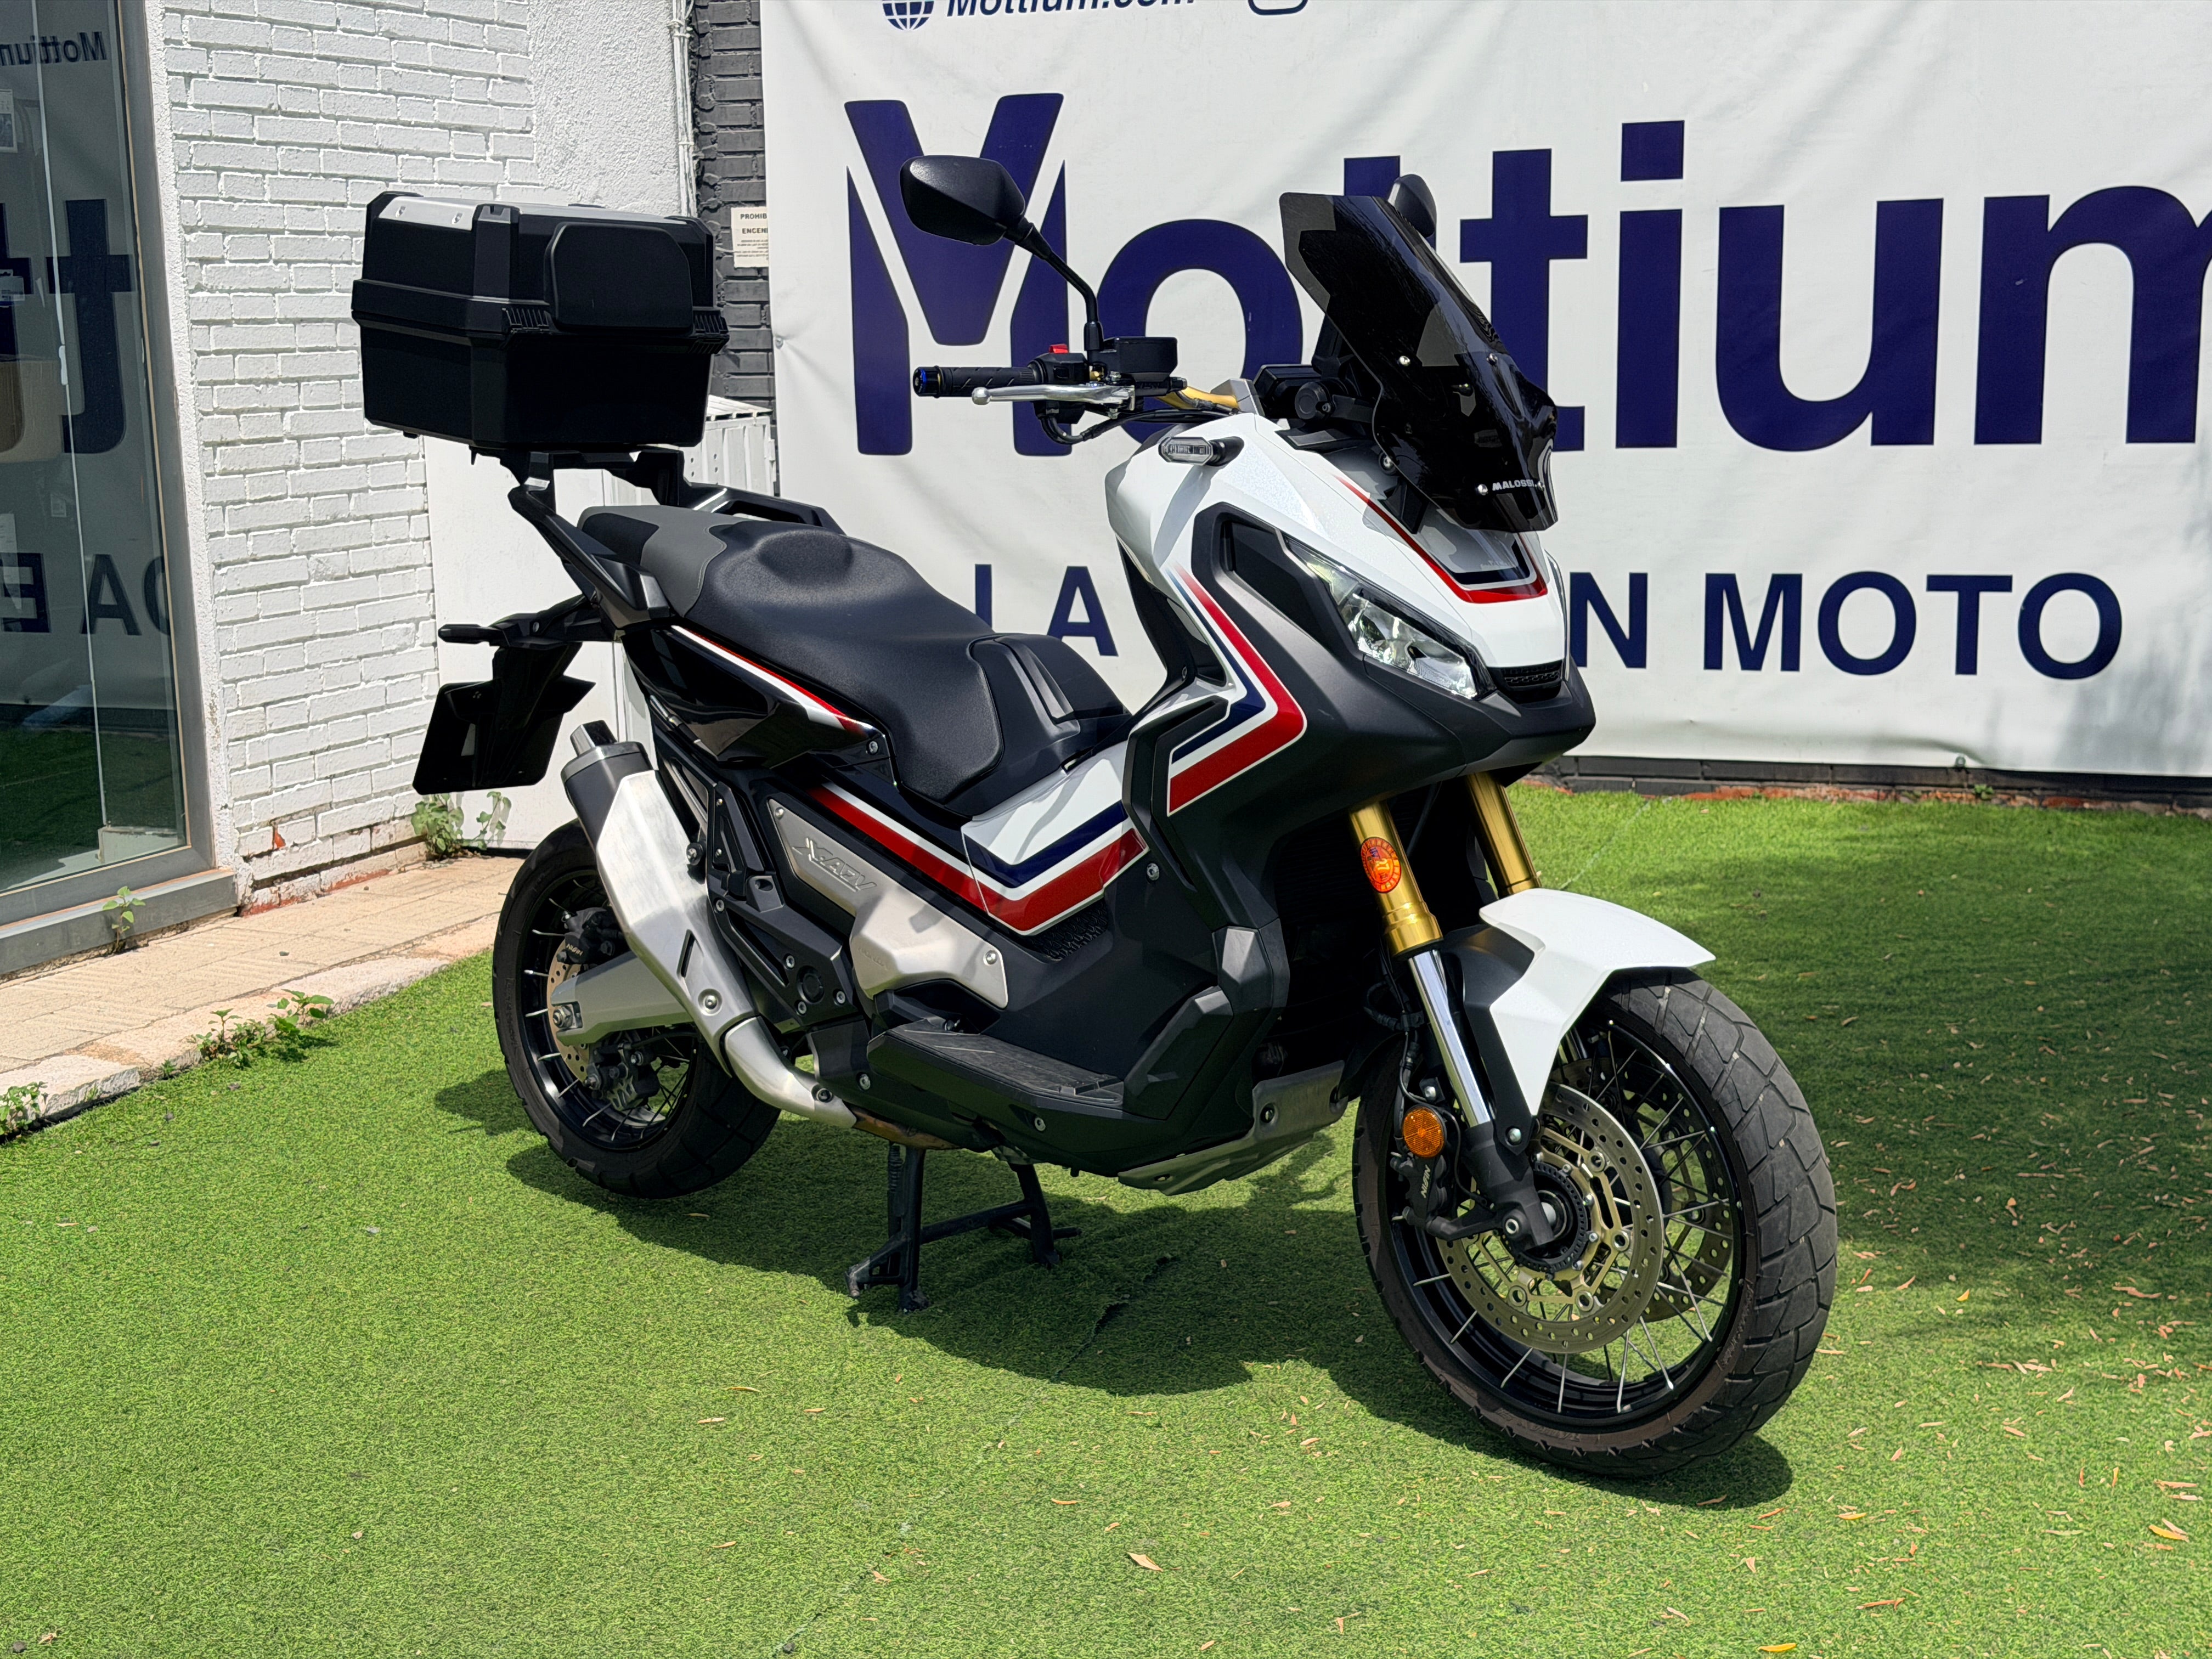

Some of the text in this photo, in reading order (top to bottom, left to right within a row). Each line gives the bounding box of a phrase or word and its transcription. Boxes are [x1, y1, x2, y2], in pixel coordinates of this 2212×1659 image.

[844, 93, 2212, 456] Motium
[1492, 479, 1534, 491] MALOSSI
[1703, 571, 2122, 680] MOTO
